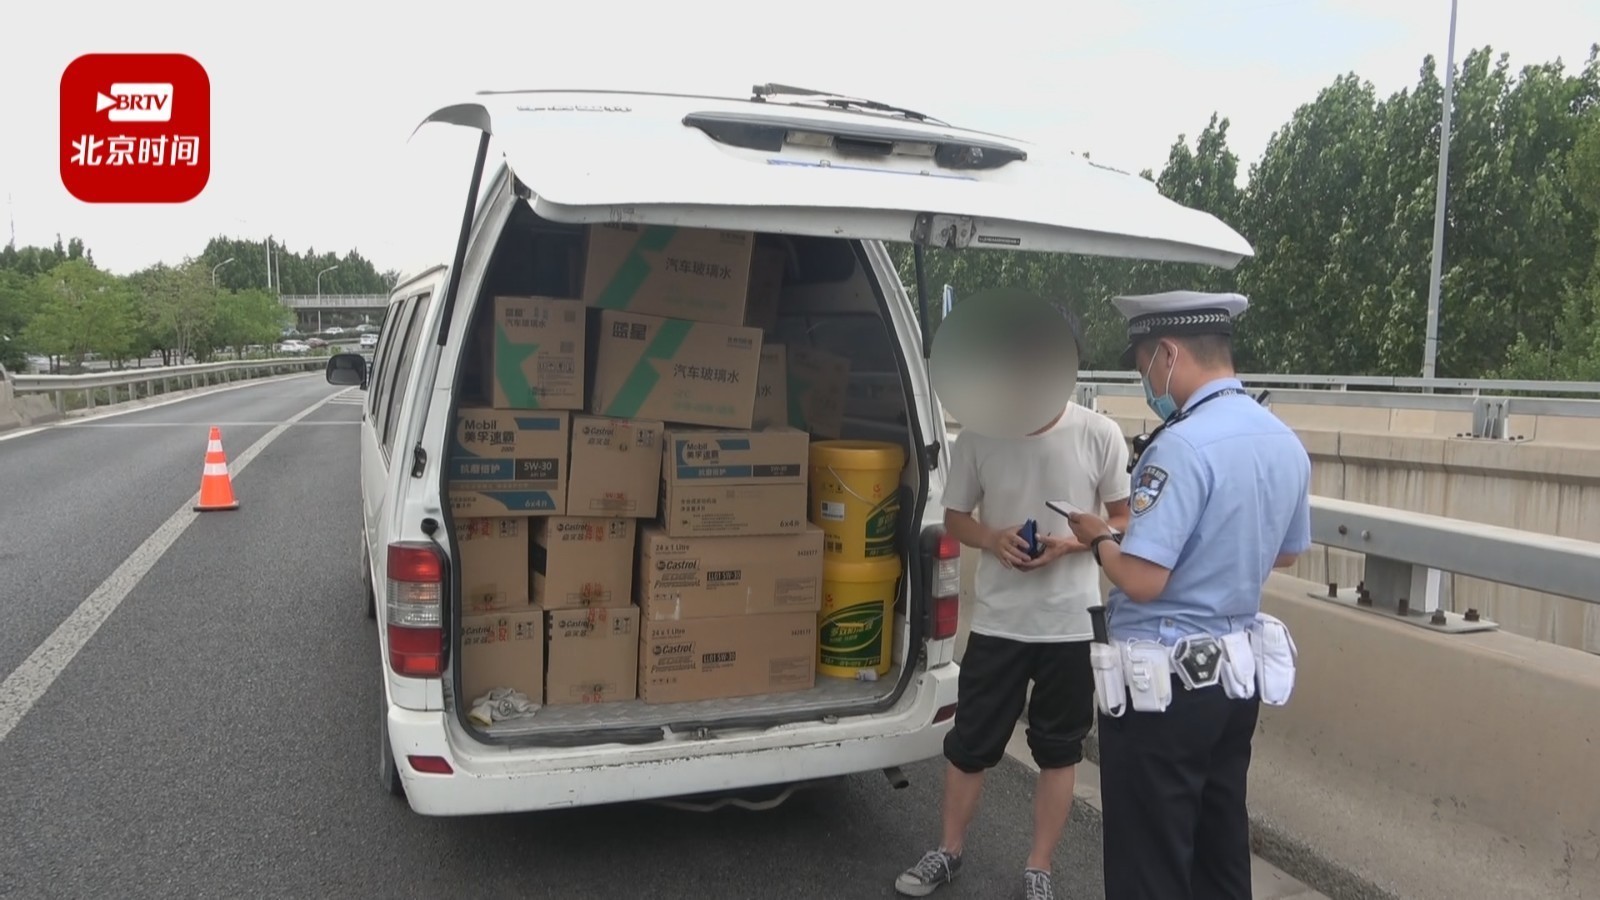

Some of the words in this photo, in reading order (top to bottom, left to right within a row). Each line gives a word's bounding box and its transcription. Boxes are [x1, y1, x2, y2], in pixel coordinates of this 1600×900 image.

[665, 257, 731, 279] 汽车玻璃水
[673, 363, 739, 383] 汽车玻璃水
[465, 420, 497, 430] Mobil
[591, 427, 614, 436] Castrol
[464, 431, 515, 445] 美孚速霸
[524, 462, 552, 471] 5W-30
[565, 522, 588, 531] Castrol
[666, 559, 697, 570] Castrol
[654, 579, 700, 589] Professional
[662, 644, 692, 654] Castrol
